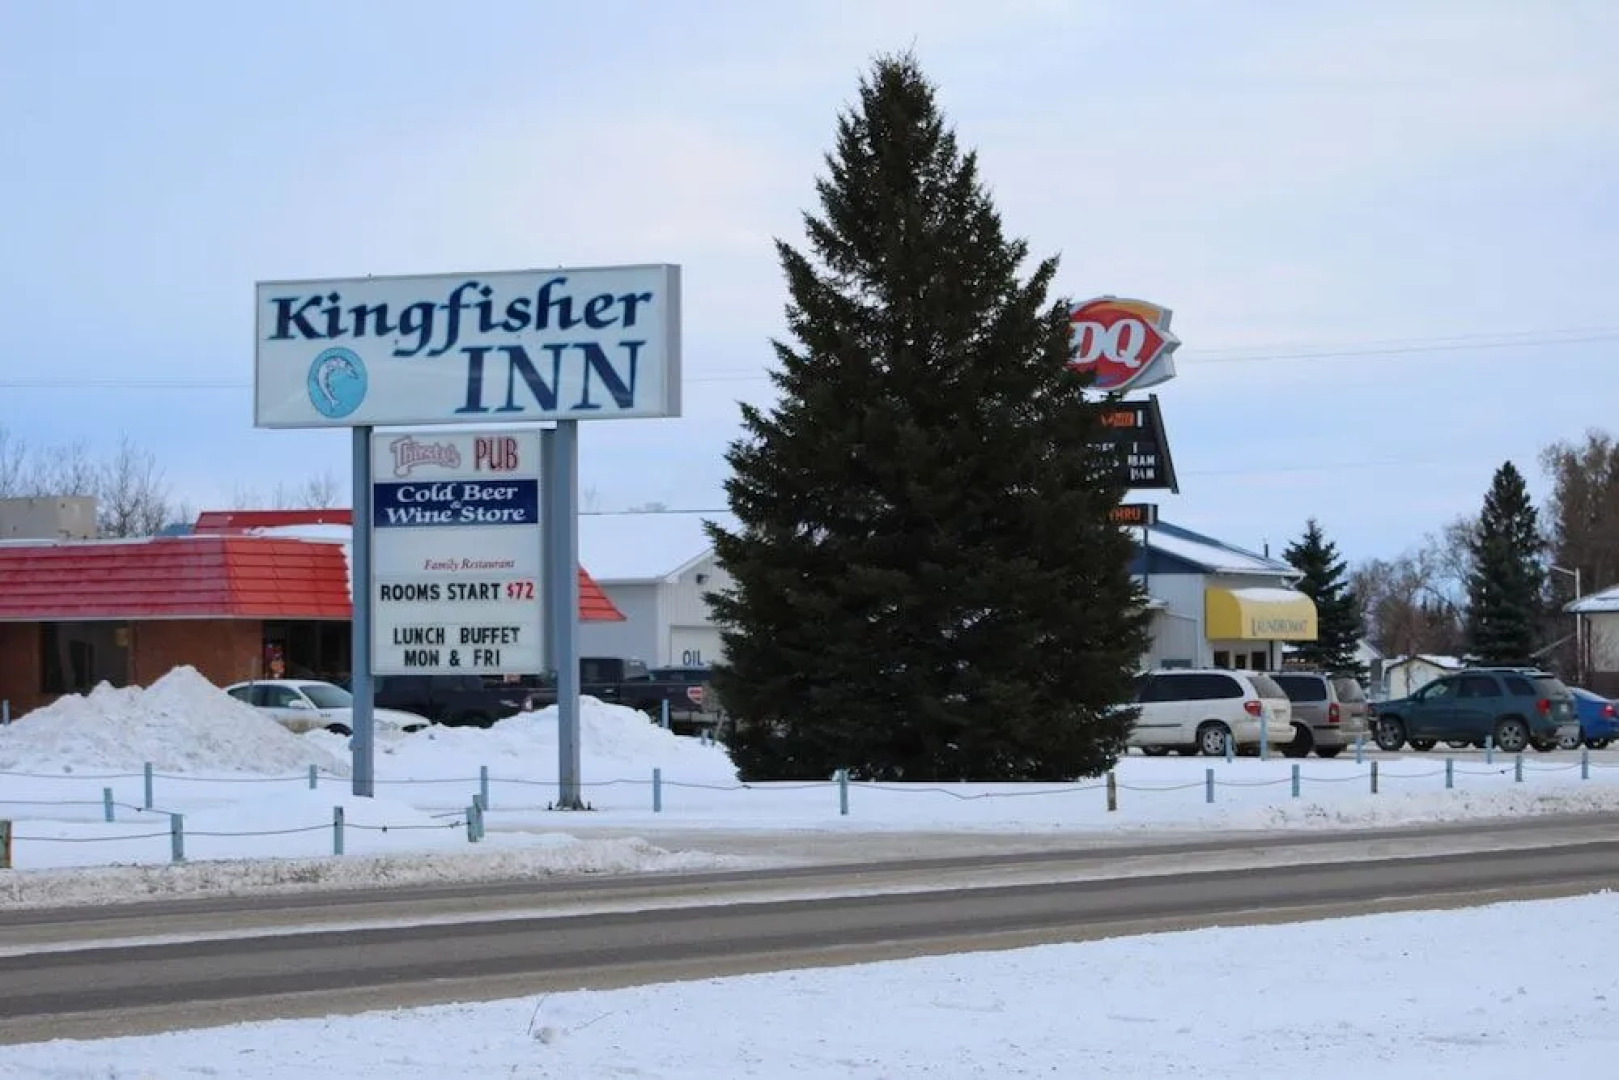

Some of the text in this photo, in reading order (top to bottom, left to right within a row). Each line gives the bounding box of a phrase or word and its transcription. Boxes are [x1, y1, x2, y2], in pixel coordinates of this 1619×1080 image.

[267, 277, 655, 358] Kingfisher
[1068, 318, 1145, 369] DQ
[454, 340, 646, 414] INN
[474, 436, 519, 472] PUB
[396, 482, 519, 503] Cold Beer
[385, 506, 527, 524] Wine Store
[423, 558, 515, 572] Family Restaurant
[380, 581, 534, 601] ROOMS START $72
[393, 626, 521, 645] LUNCH BUFFET
[404, 650, 500, 667] MON & FRI
[682, 650, 704, 667] OIL
